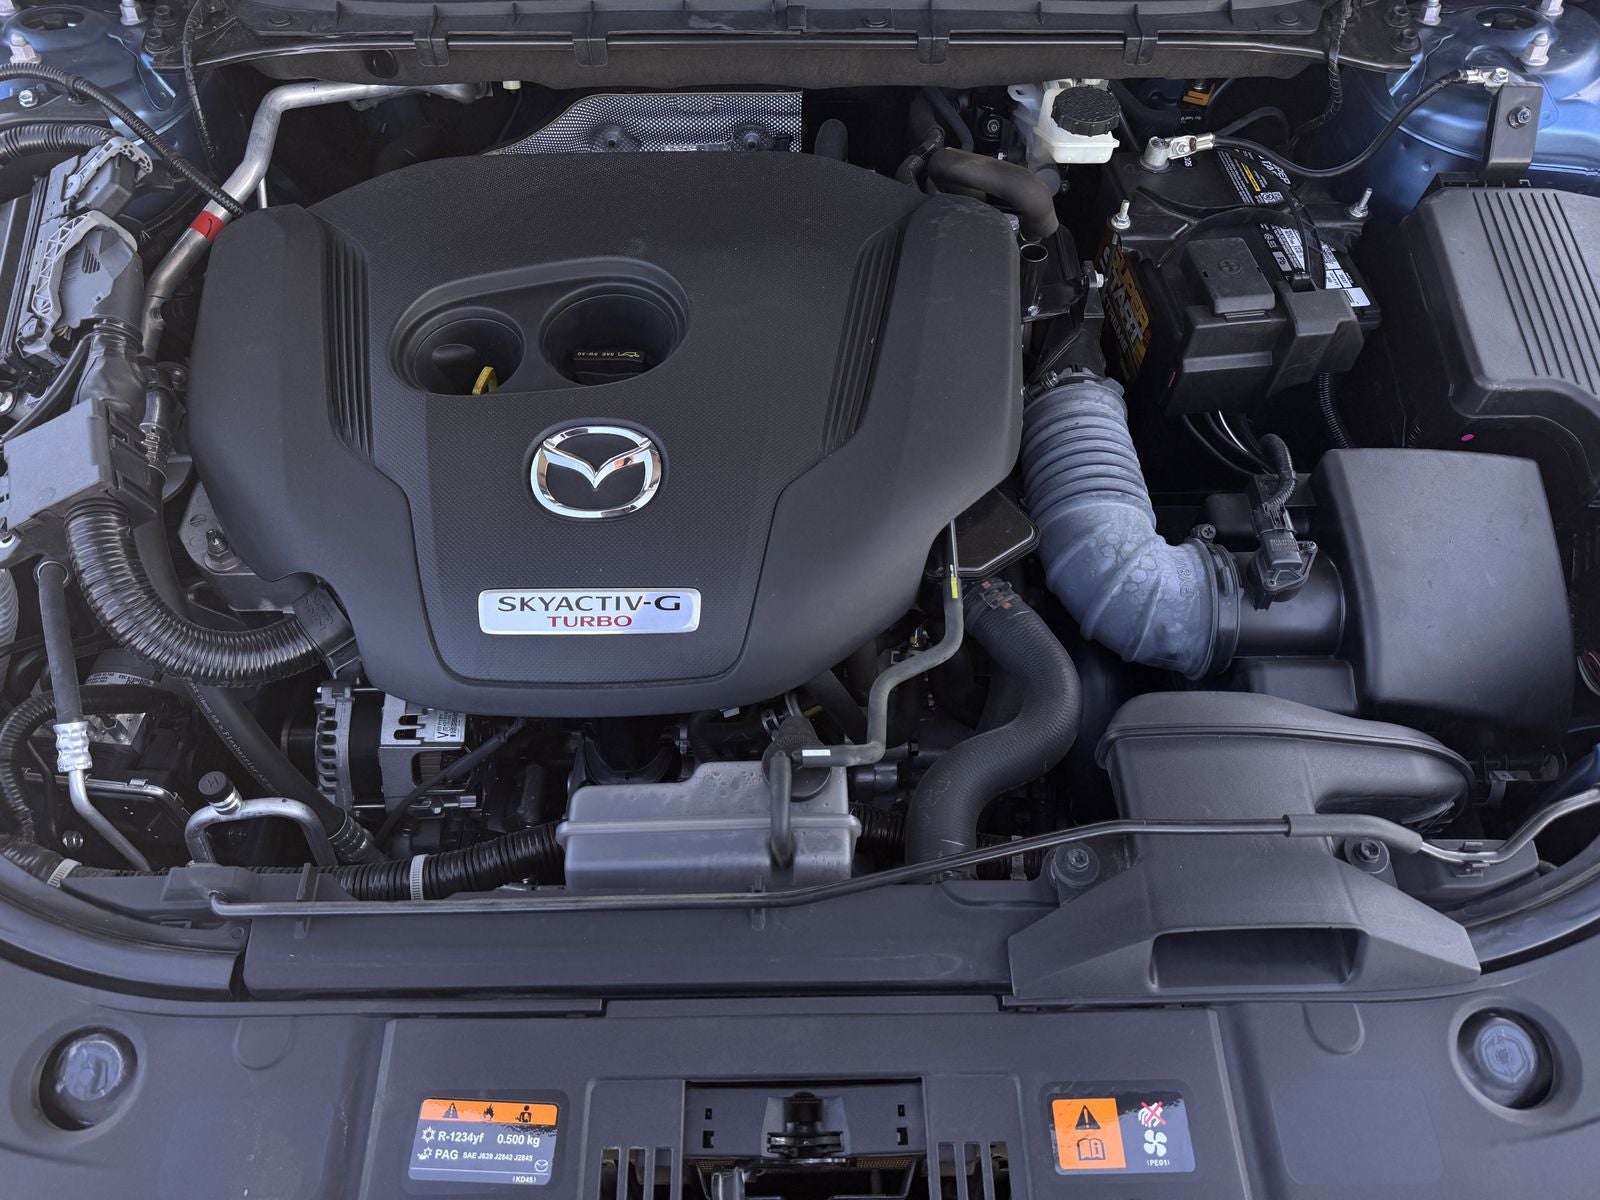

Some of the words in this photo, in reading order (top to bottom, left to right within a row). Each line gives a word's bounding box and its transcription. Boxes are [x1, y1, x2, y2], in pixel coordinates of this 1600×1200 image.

[497, 595, 681, 612] SKYACTIV-G
[547, 615, 633, 628] TURBO
[437, 1130, 485, 1145] R-1234yf
[497, 1133, 525, 1145] 0.500
[526, 1134, 541, 1148] kg
[434, 1148, 459, 1160] PAG
[493, 1153, 513, 1161] J2842
[513, 1154, 533, 1162] J2845
